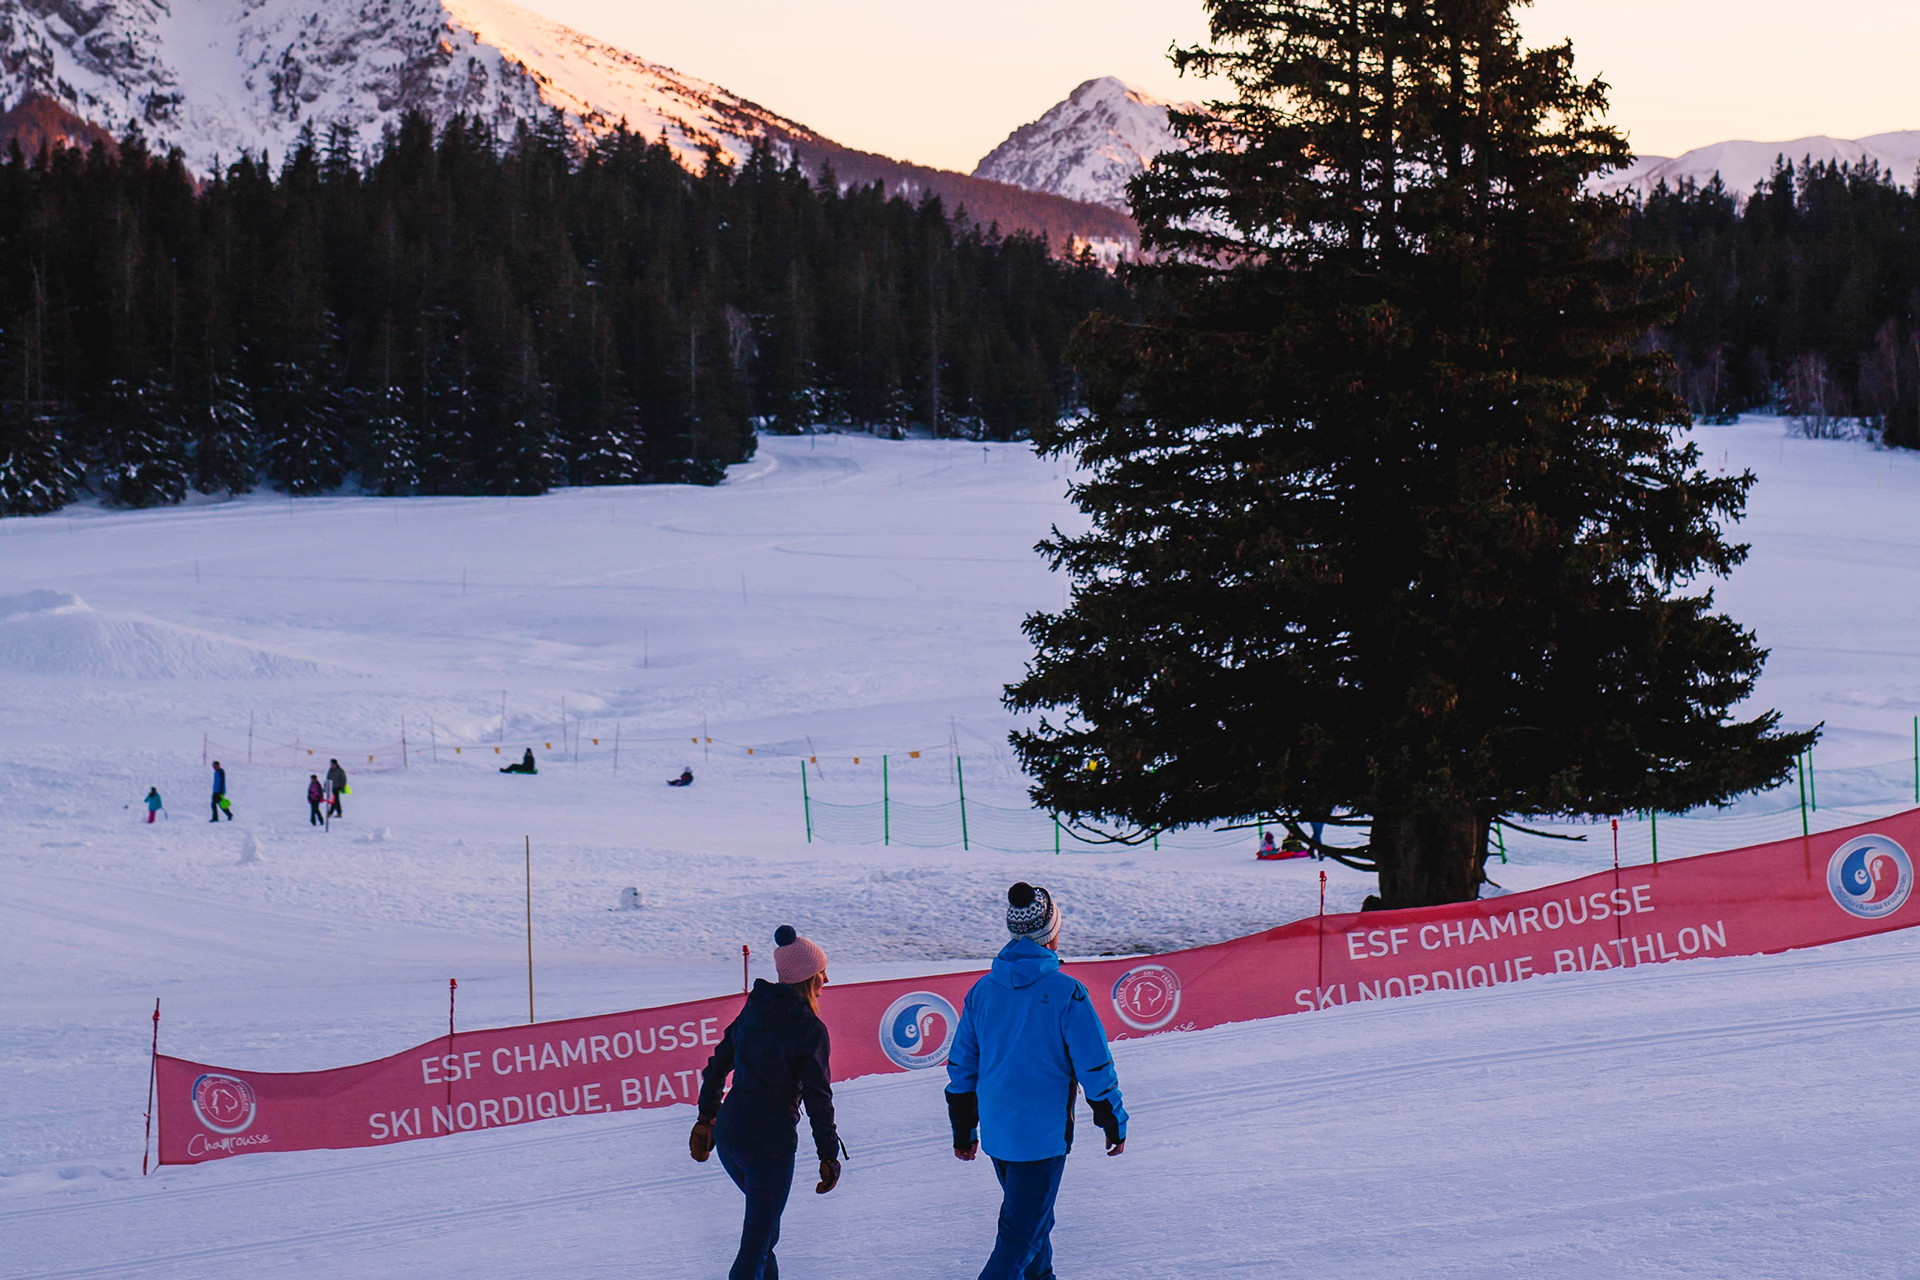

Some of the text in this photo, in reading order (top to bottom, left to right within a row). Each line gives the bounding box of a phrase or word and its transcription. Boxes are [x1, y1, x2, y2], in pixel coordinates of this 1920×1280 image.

[1346, 883, 1655, 960] ESF CHAMROUSSE
[1294, 983, 1348, 1012] SKI
[1553, 920, 1727, 973] BIATHLON
[421, 1017, 720, 1085] ESF CHAMROUSSE
[187, 1133, 272, 1157] Chamrousse
[368, 1107, 422, 1140] SKI
[431, 1083, 613, 1133] NORDIQUE,
